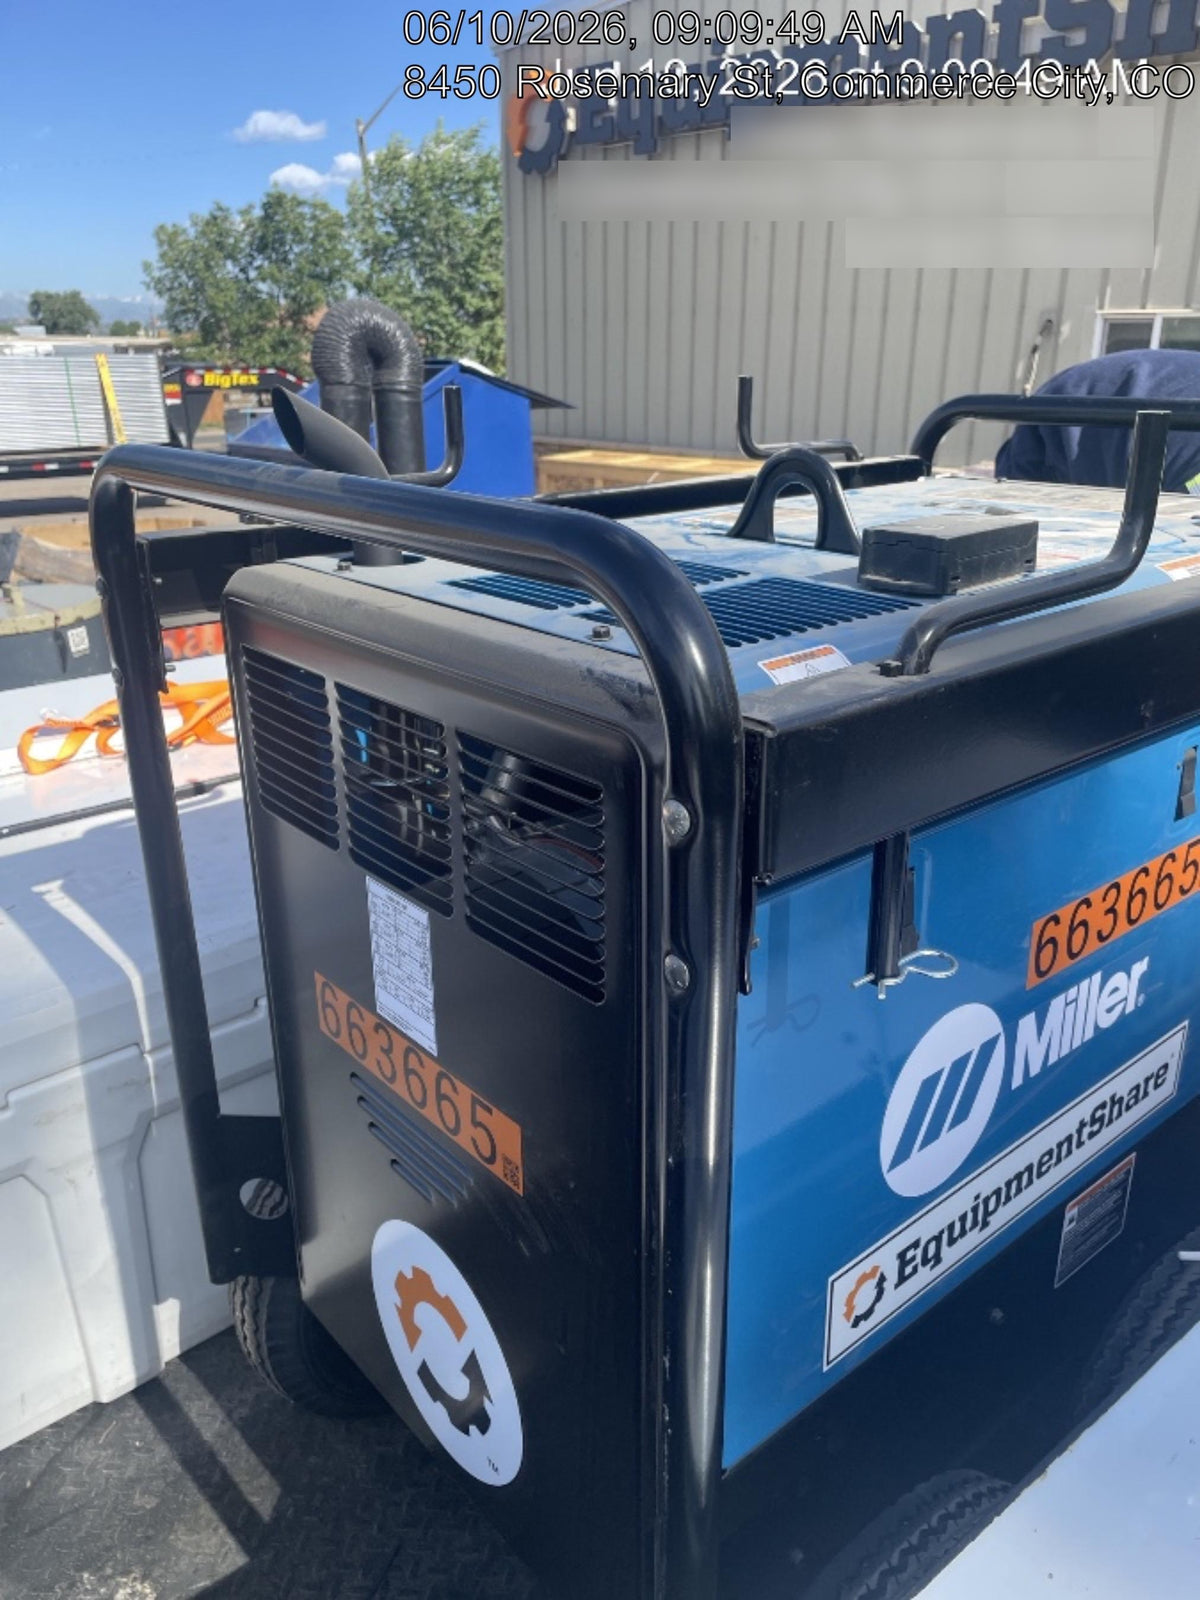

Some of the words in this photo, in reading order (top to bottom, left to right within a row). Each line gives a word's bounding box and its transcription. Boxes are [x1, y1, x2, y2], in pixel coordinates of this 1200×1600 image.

[1034, 837, 1200, 978] 663665
[320, 980, 498, 1166] 663665
[1011, 956, 1150, 1091] Miller
[893, 1060, 1171, 1291] EquipmentShare
[487, 1456, 500, 1475] TM
